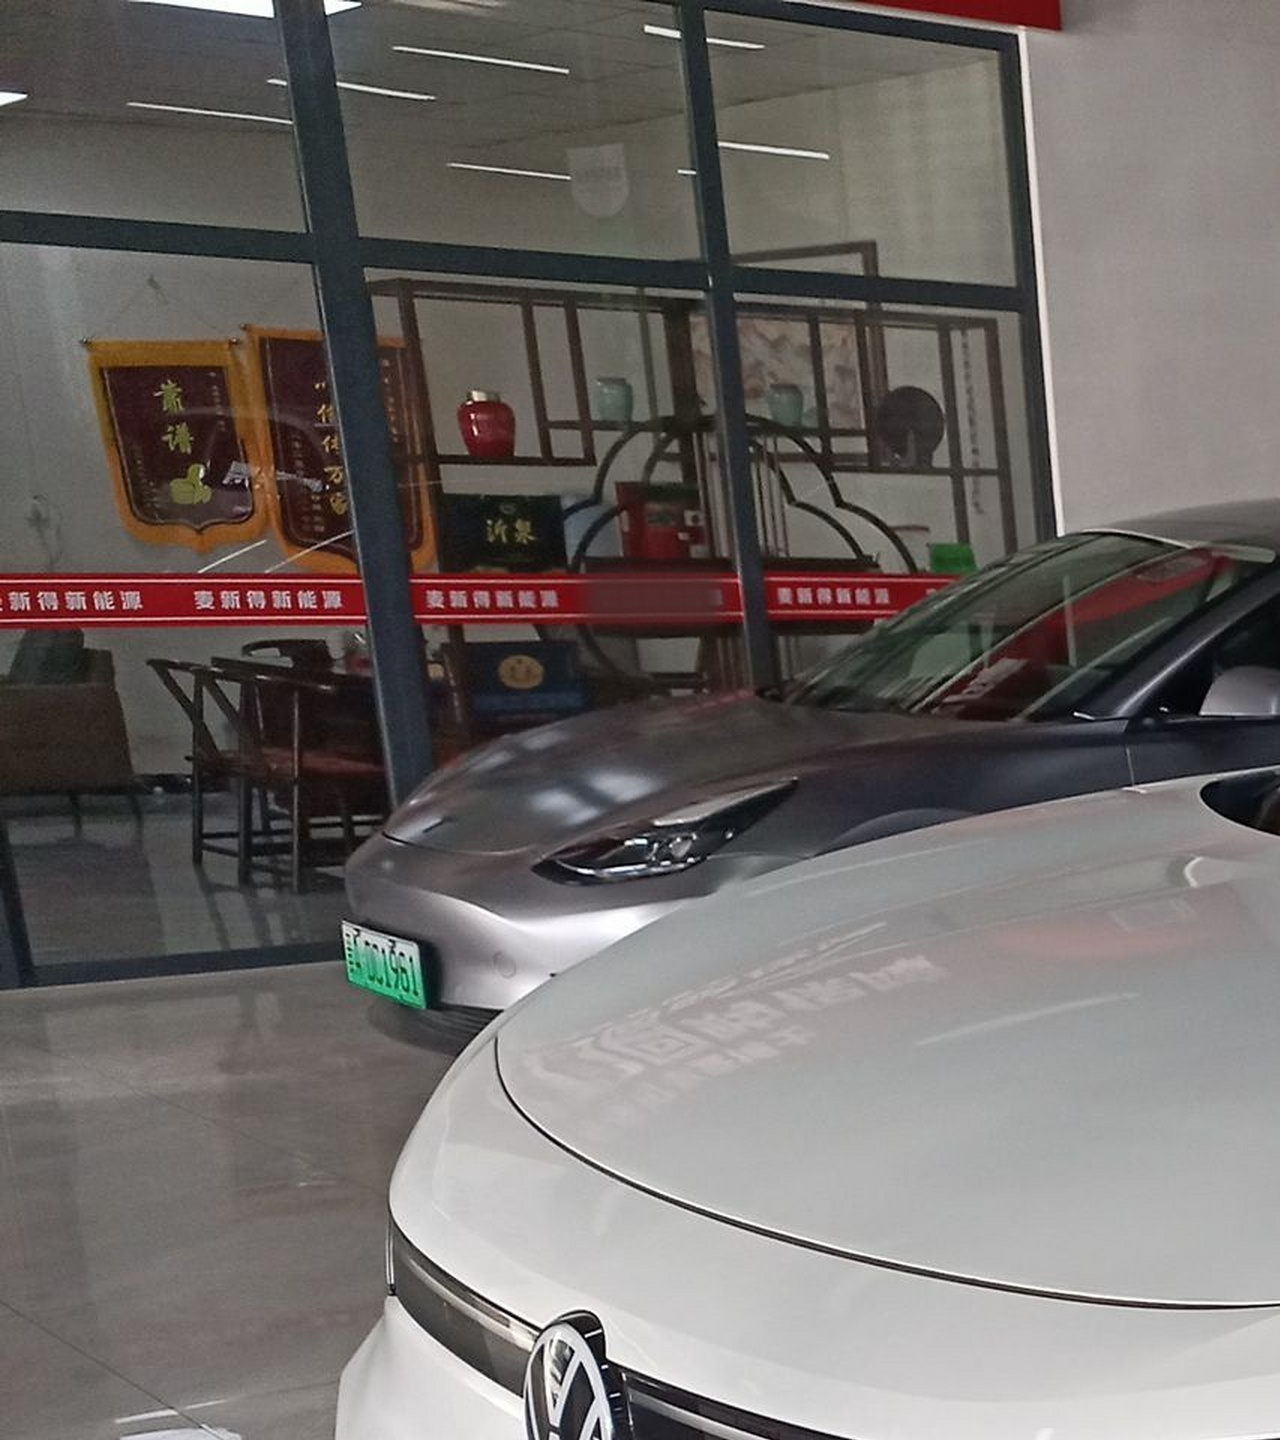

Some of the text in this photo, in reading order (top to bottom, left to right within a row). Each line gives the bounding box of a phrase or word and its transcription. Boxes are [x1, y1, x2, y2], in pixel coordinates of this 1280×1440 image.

[0, 590, 143, 611] 新得新能源
